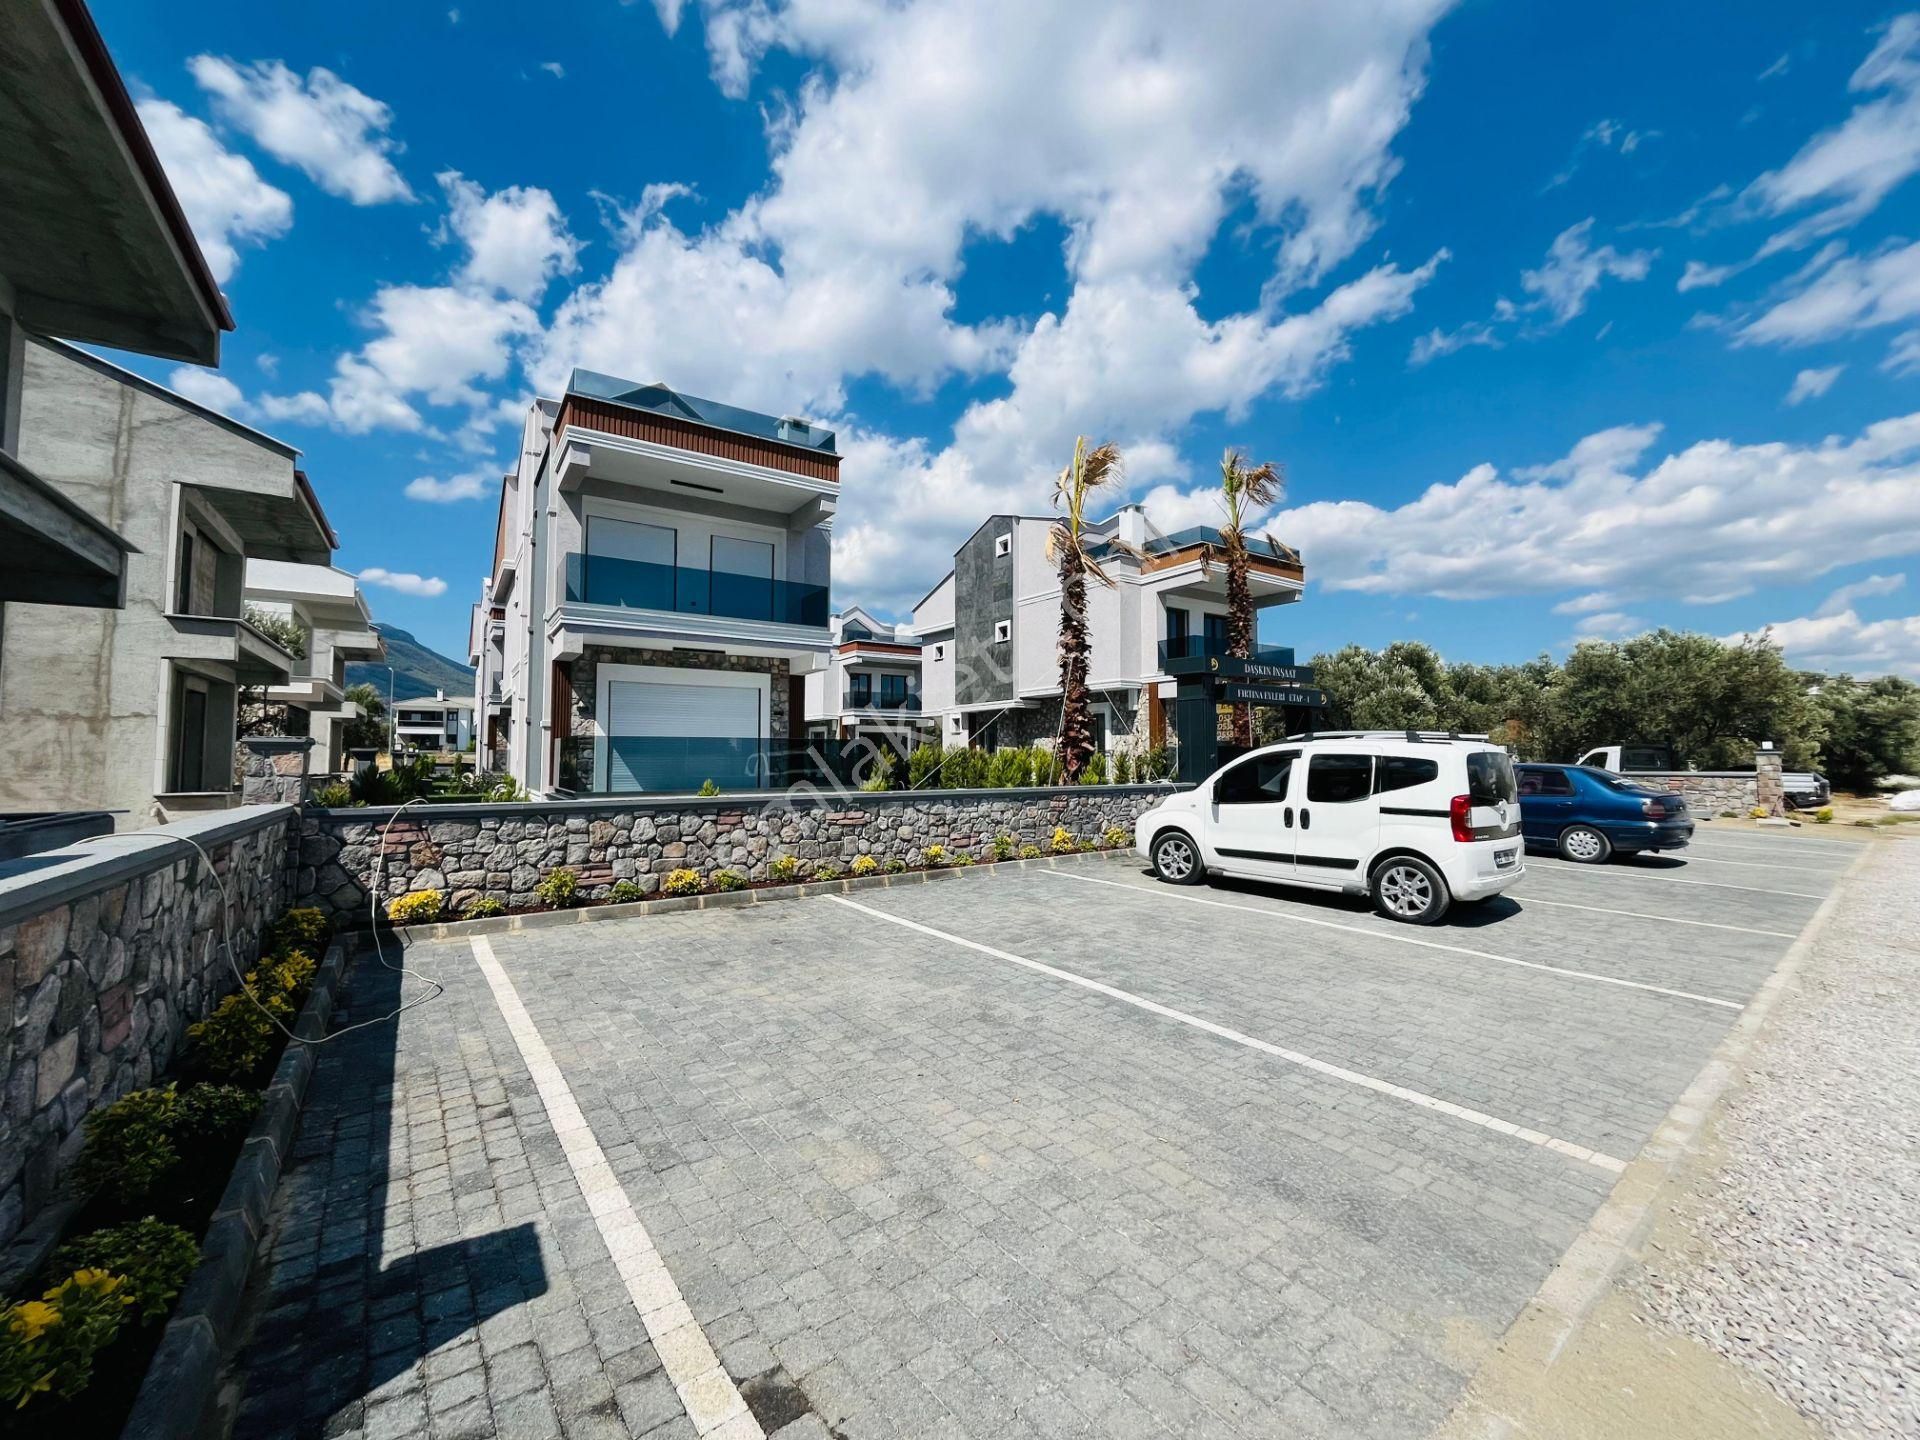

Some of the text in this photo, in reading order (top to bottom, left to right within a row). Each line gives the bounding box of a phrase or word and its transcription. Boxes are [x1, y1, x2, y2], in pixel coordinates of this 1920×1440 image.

[1244, 663, 1296, 679] DAŞKIN İNŞAAT
[1237, 688, 1263, 700] FIRTINA
[1288, 693, 1303, 702] ETAP
